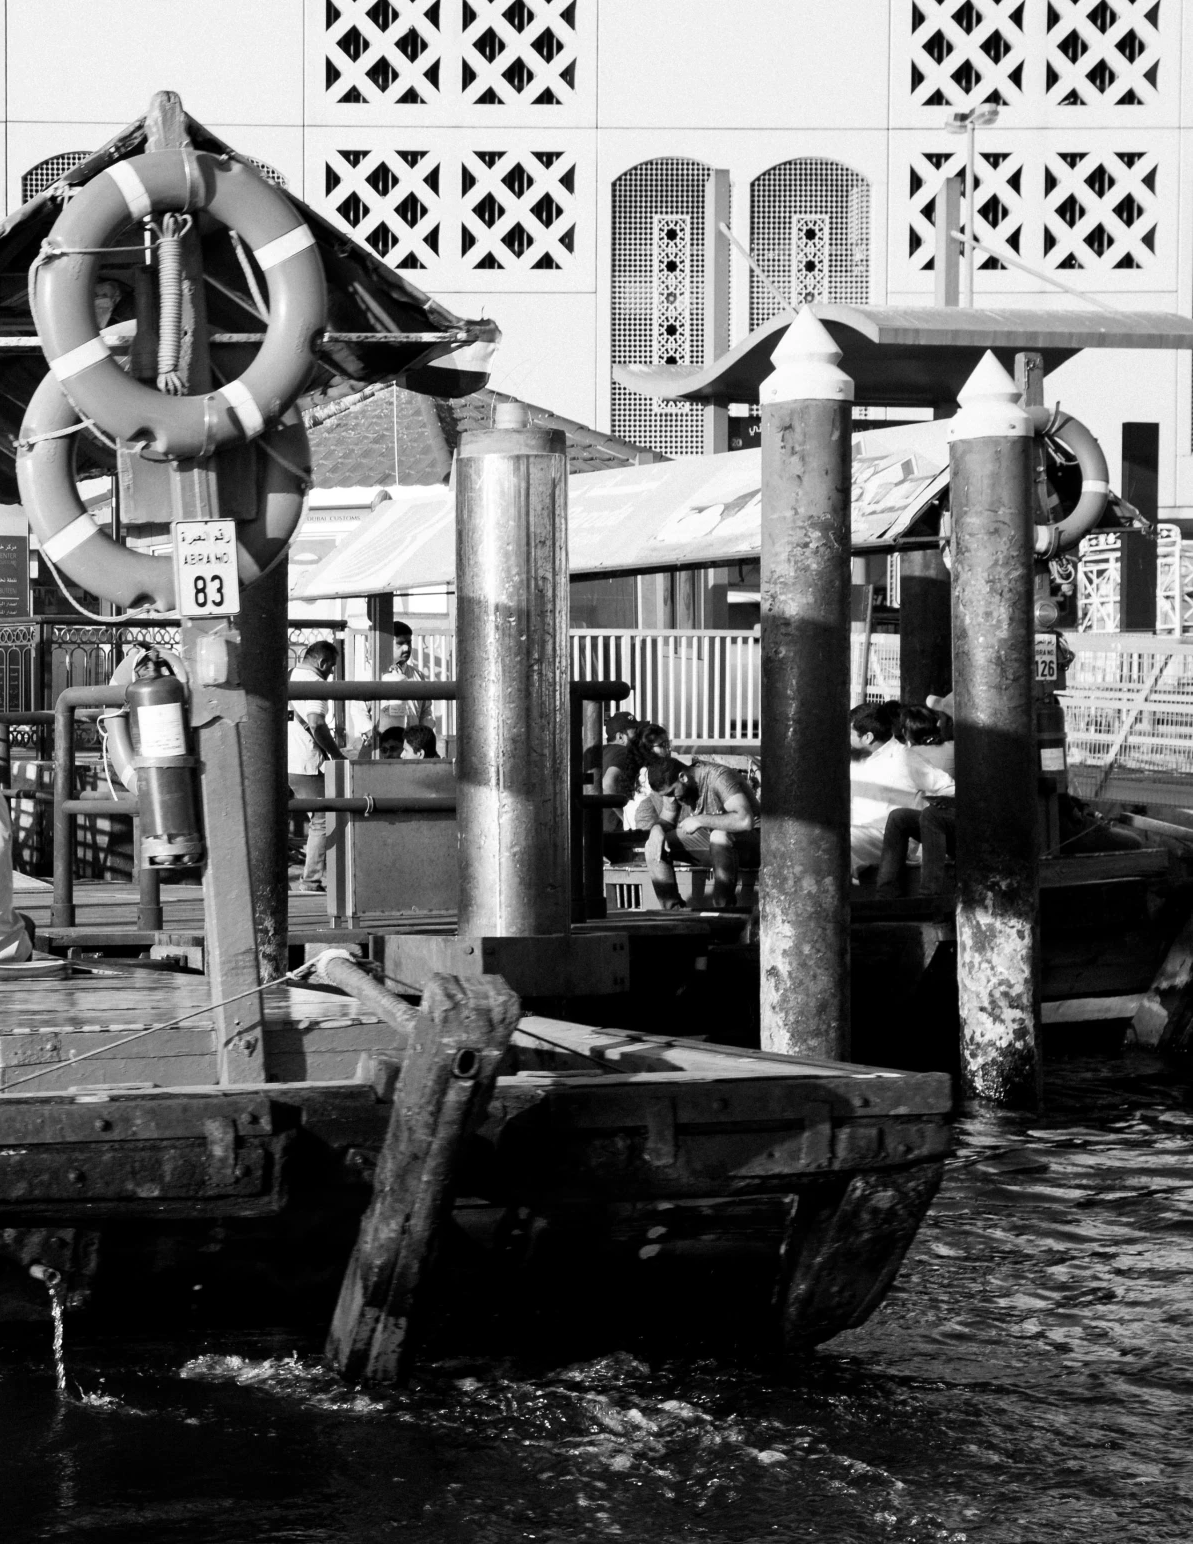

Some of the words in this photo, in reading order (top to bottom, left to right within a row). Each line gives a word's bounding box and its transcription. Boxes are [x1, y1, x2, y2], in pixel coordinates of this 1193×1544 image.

[184, 553, 212, 565] ABRA
[194, 575, 224, 607] 83
[1035, 660, 1055, 677] 126
